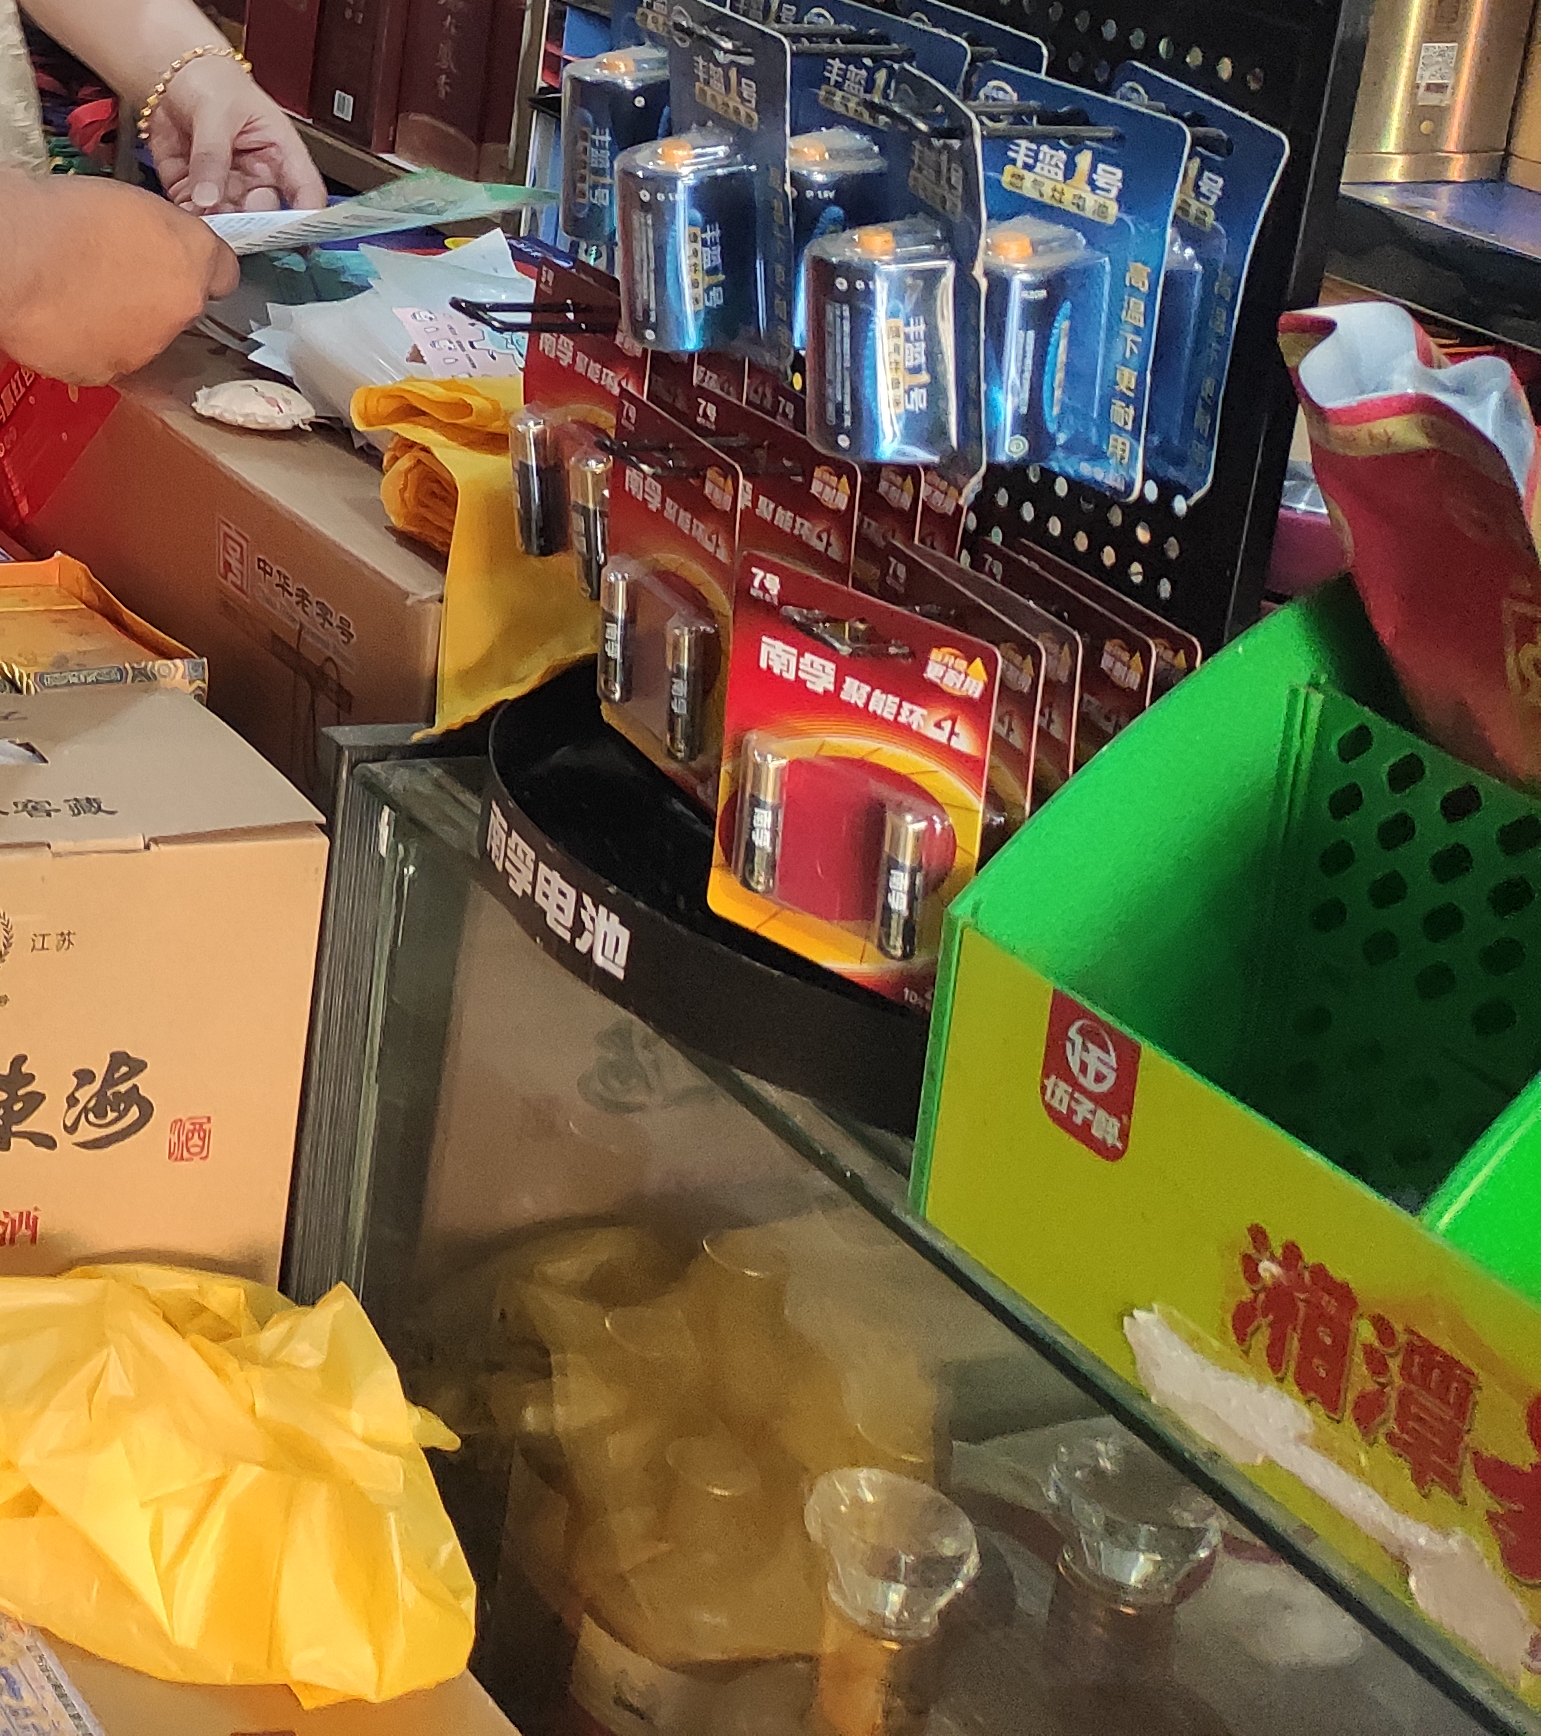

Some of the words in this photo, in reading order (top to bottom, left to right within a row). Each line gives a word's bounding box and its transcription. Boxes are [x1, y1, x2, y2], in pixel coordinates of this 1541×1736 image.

[1006, 137, 1124, 202] 丰蓝1号
[254, 556, 355, 645] 中华老字号
[750, 565, 781, 596] 7号
[759, 634, 837, 695] 南孚
[486, 799, 631, 982] 南孚电池
[29, 930, 77, 954] 江苏
